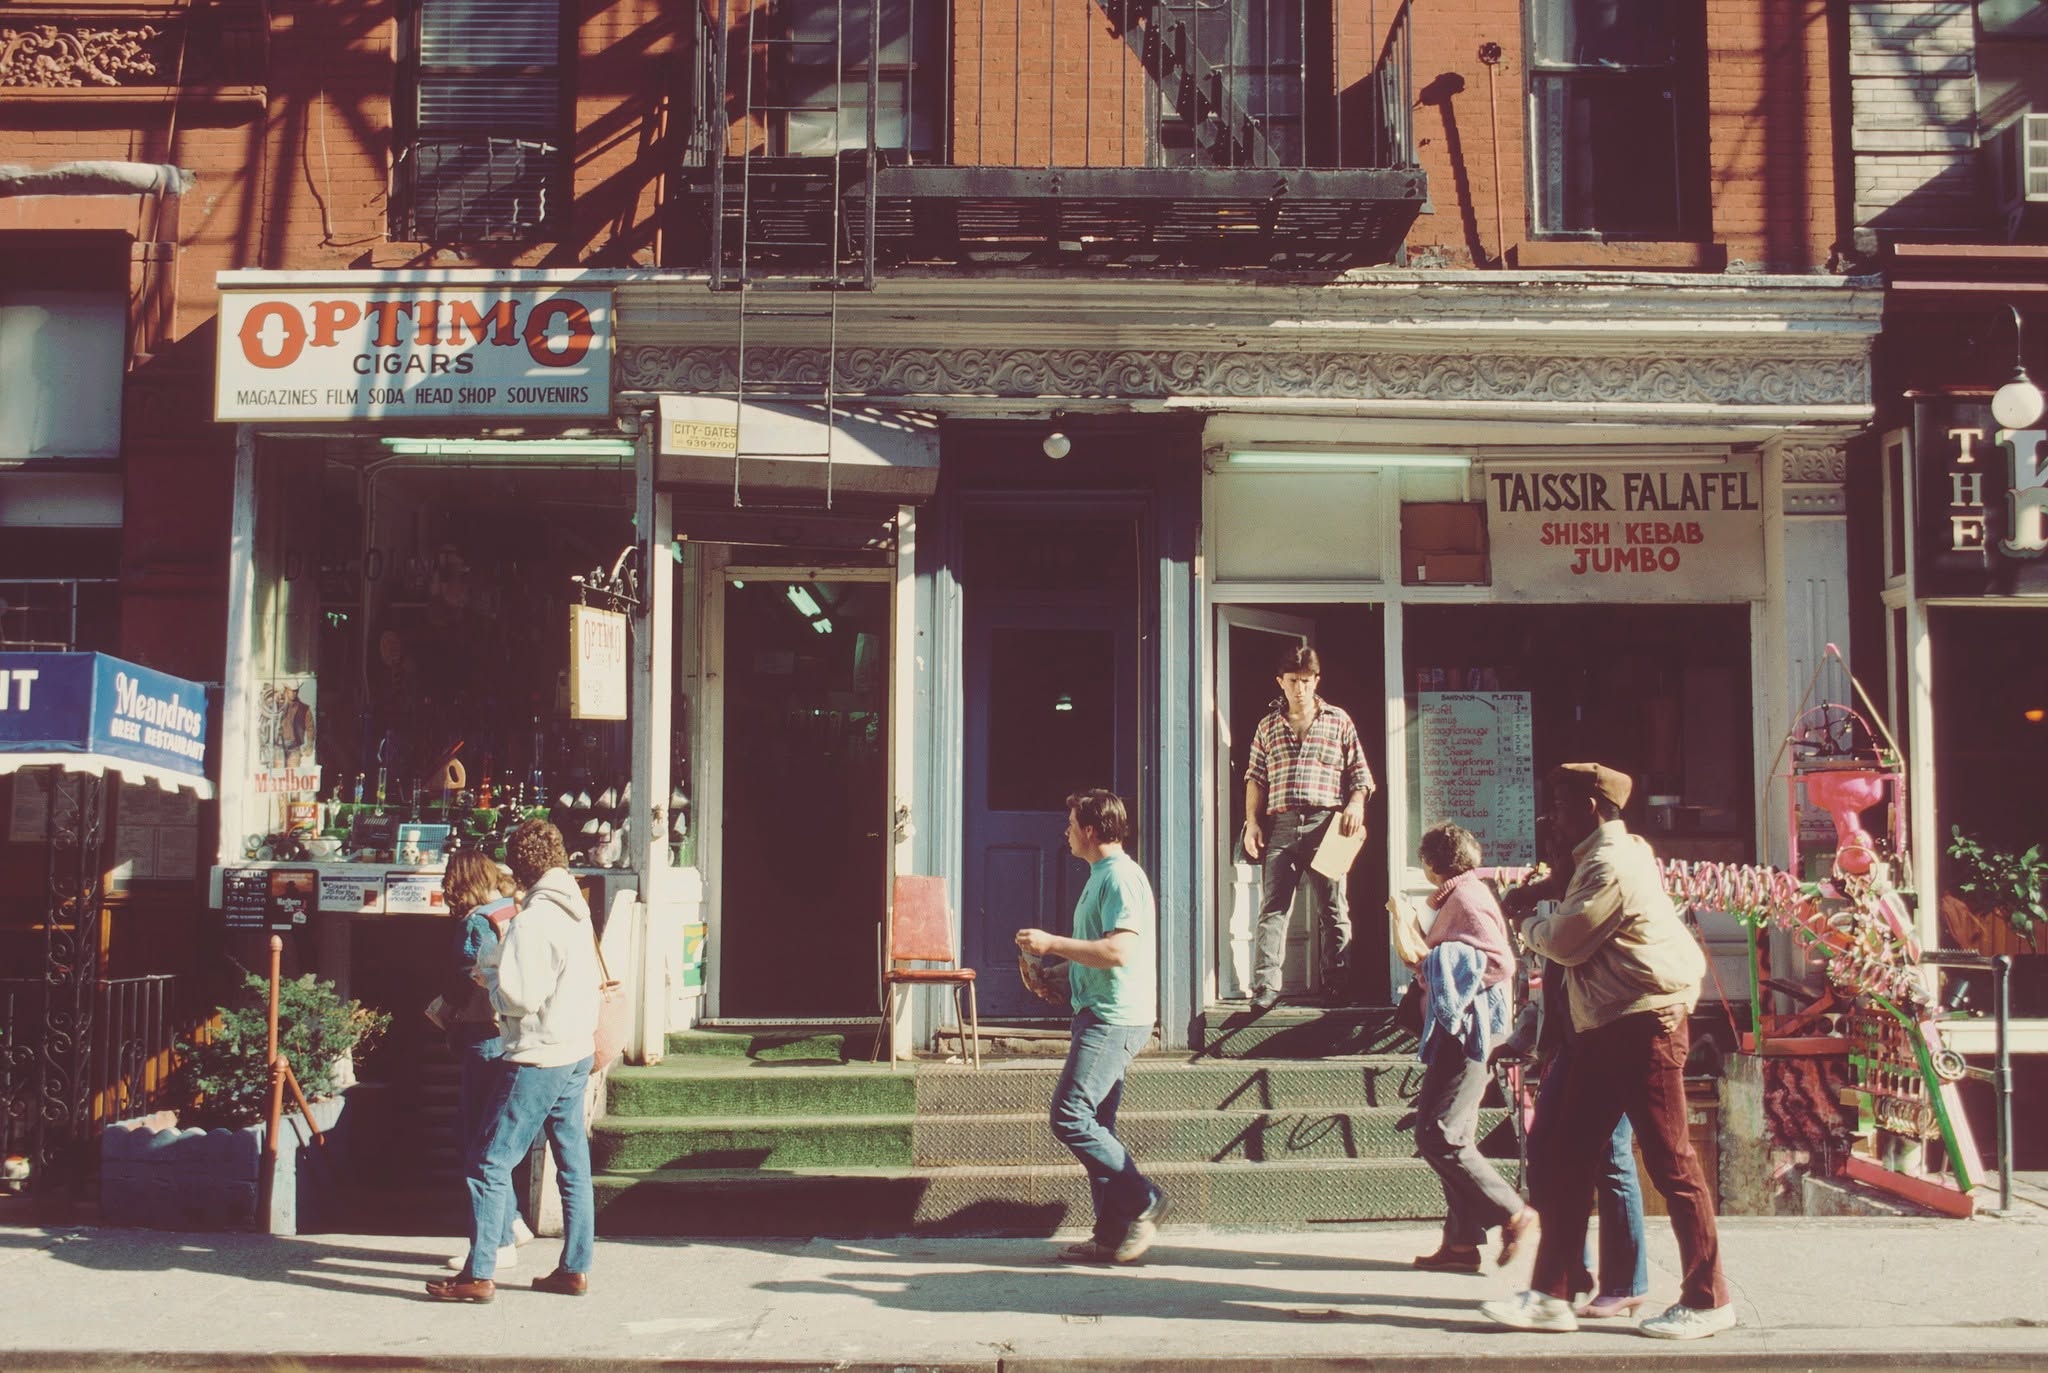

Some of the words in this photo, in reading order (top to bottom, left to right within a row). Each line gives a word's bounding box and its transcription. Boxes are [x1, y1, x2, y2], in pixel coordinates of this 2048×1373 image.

[237, 299, 596, 369] OPTIMO
[353, 353, 474, 375] CIGARS
[236, 389, 318, 406] MAGAZINES
[326, 388, 359, 405] FILM
[367, 388, 405, 404] SODA
[415, 387, 453, 404] HEAD
[458, 387, 496, 404] SHOP
[507, 386, 589, 403] SOUVENIRS
[674, 424, 737, 438] CITY-GATES
[1491, 472, 1616, 512] TAISSIR
[1622, 472, 1758, 511] FALAFEL
[1949, 428, 1984, 551] THE
[1540, 522, 1610, 545] SHISH
[1625, 522, 1704, 545] KEBAB
[1570, 546, 1681, 575] JUMBO
[115, 671, 202, 738] Meandros
[110, 717, 141, 743] GREEK
